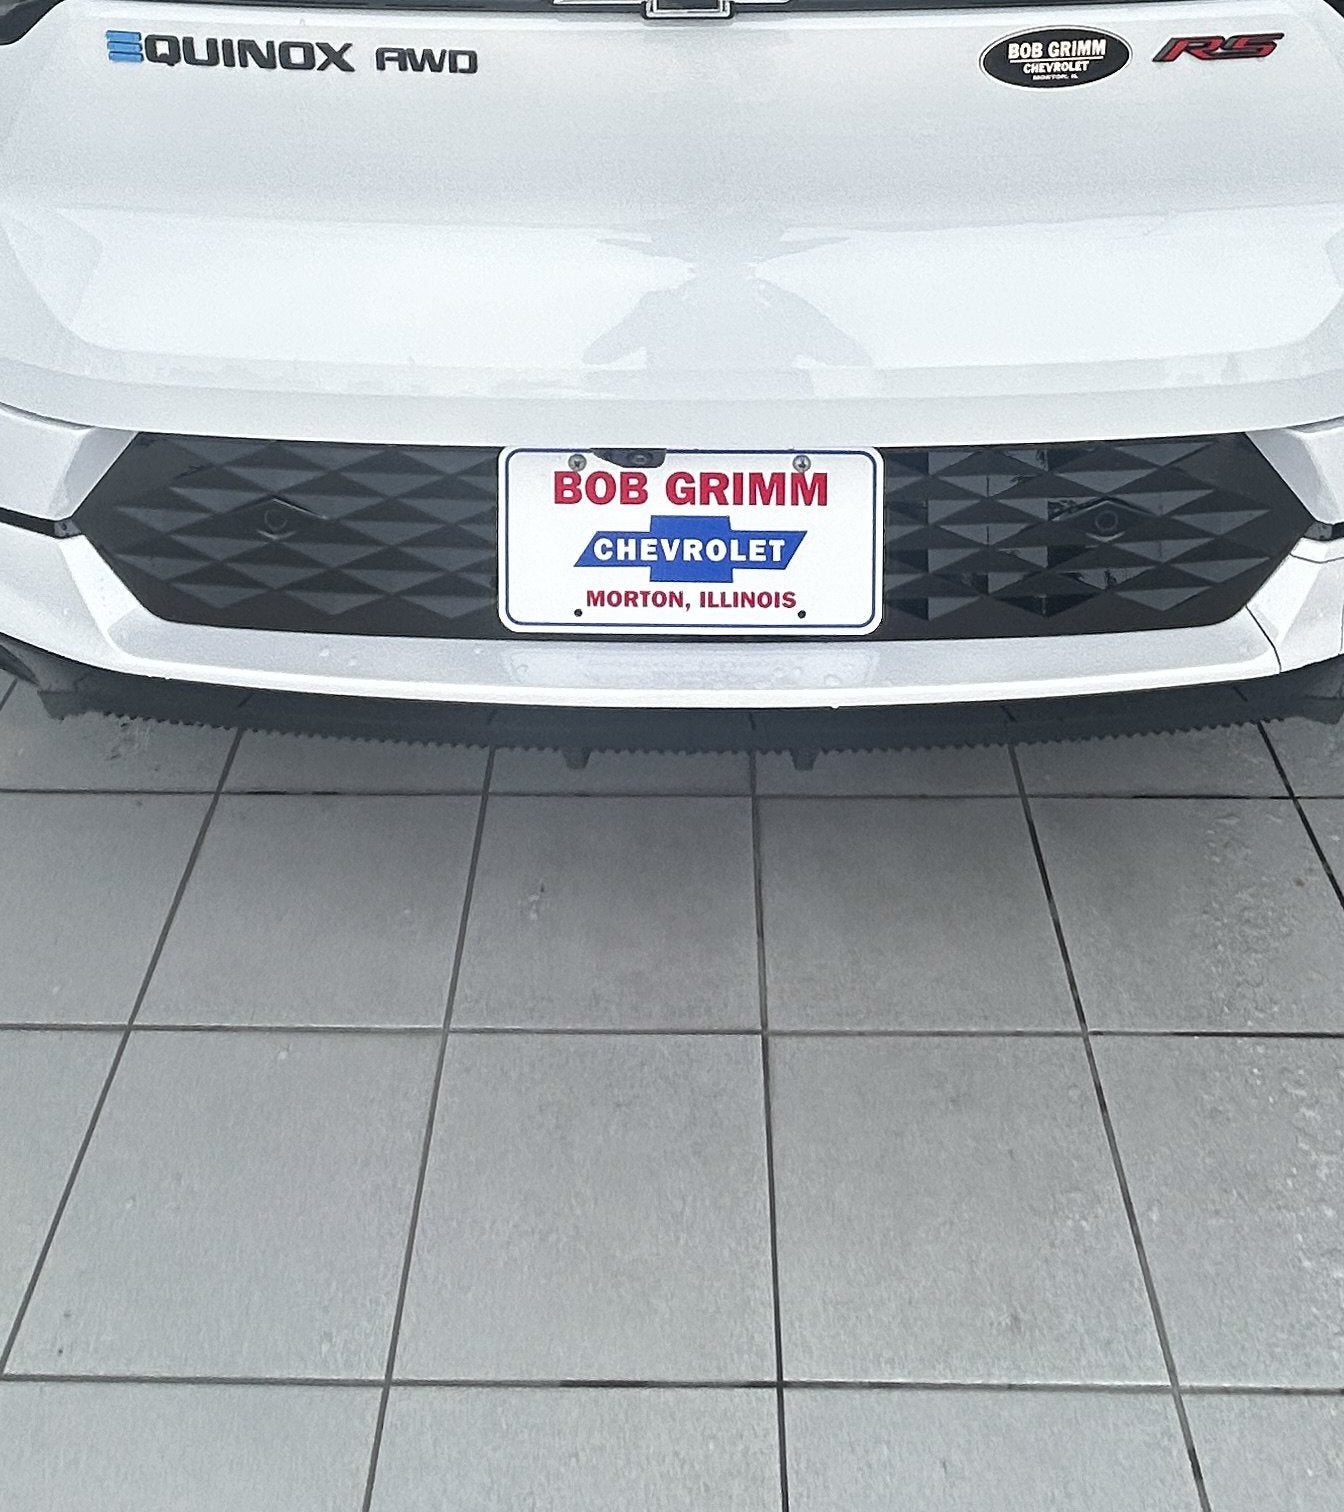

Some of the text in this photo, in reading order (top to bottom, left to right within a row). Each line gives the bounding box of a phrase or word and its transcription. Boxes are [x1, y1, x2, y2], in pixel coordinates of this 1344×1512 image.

[105, 30, 478, 74] EQUINOX AWD
[1008, 38, 1106, 60] BOB GRIMM
[1152, 32, 1285, 63] RS
[1022, 60, 1090, 74] CHEVROLET
[553, 470, 828, 506] BOB GRIMM
[593, 537, 786, 563] CHEVROLET
[586, 590, 798, 612] MORTON, ILLINOIS
